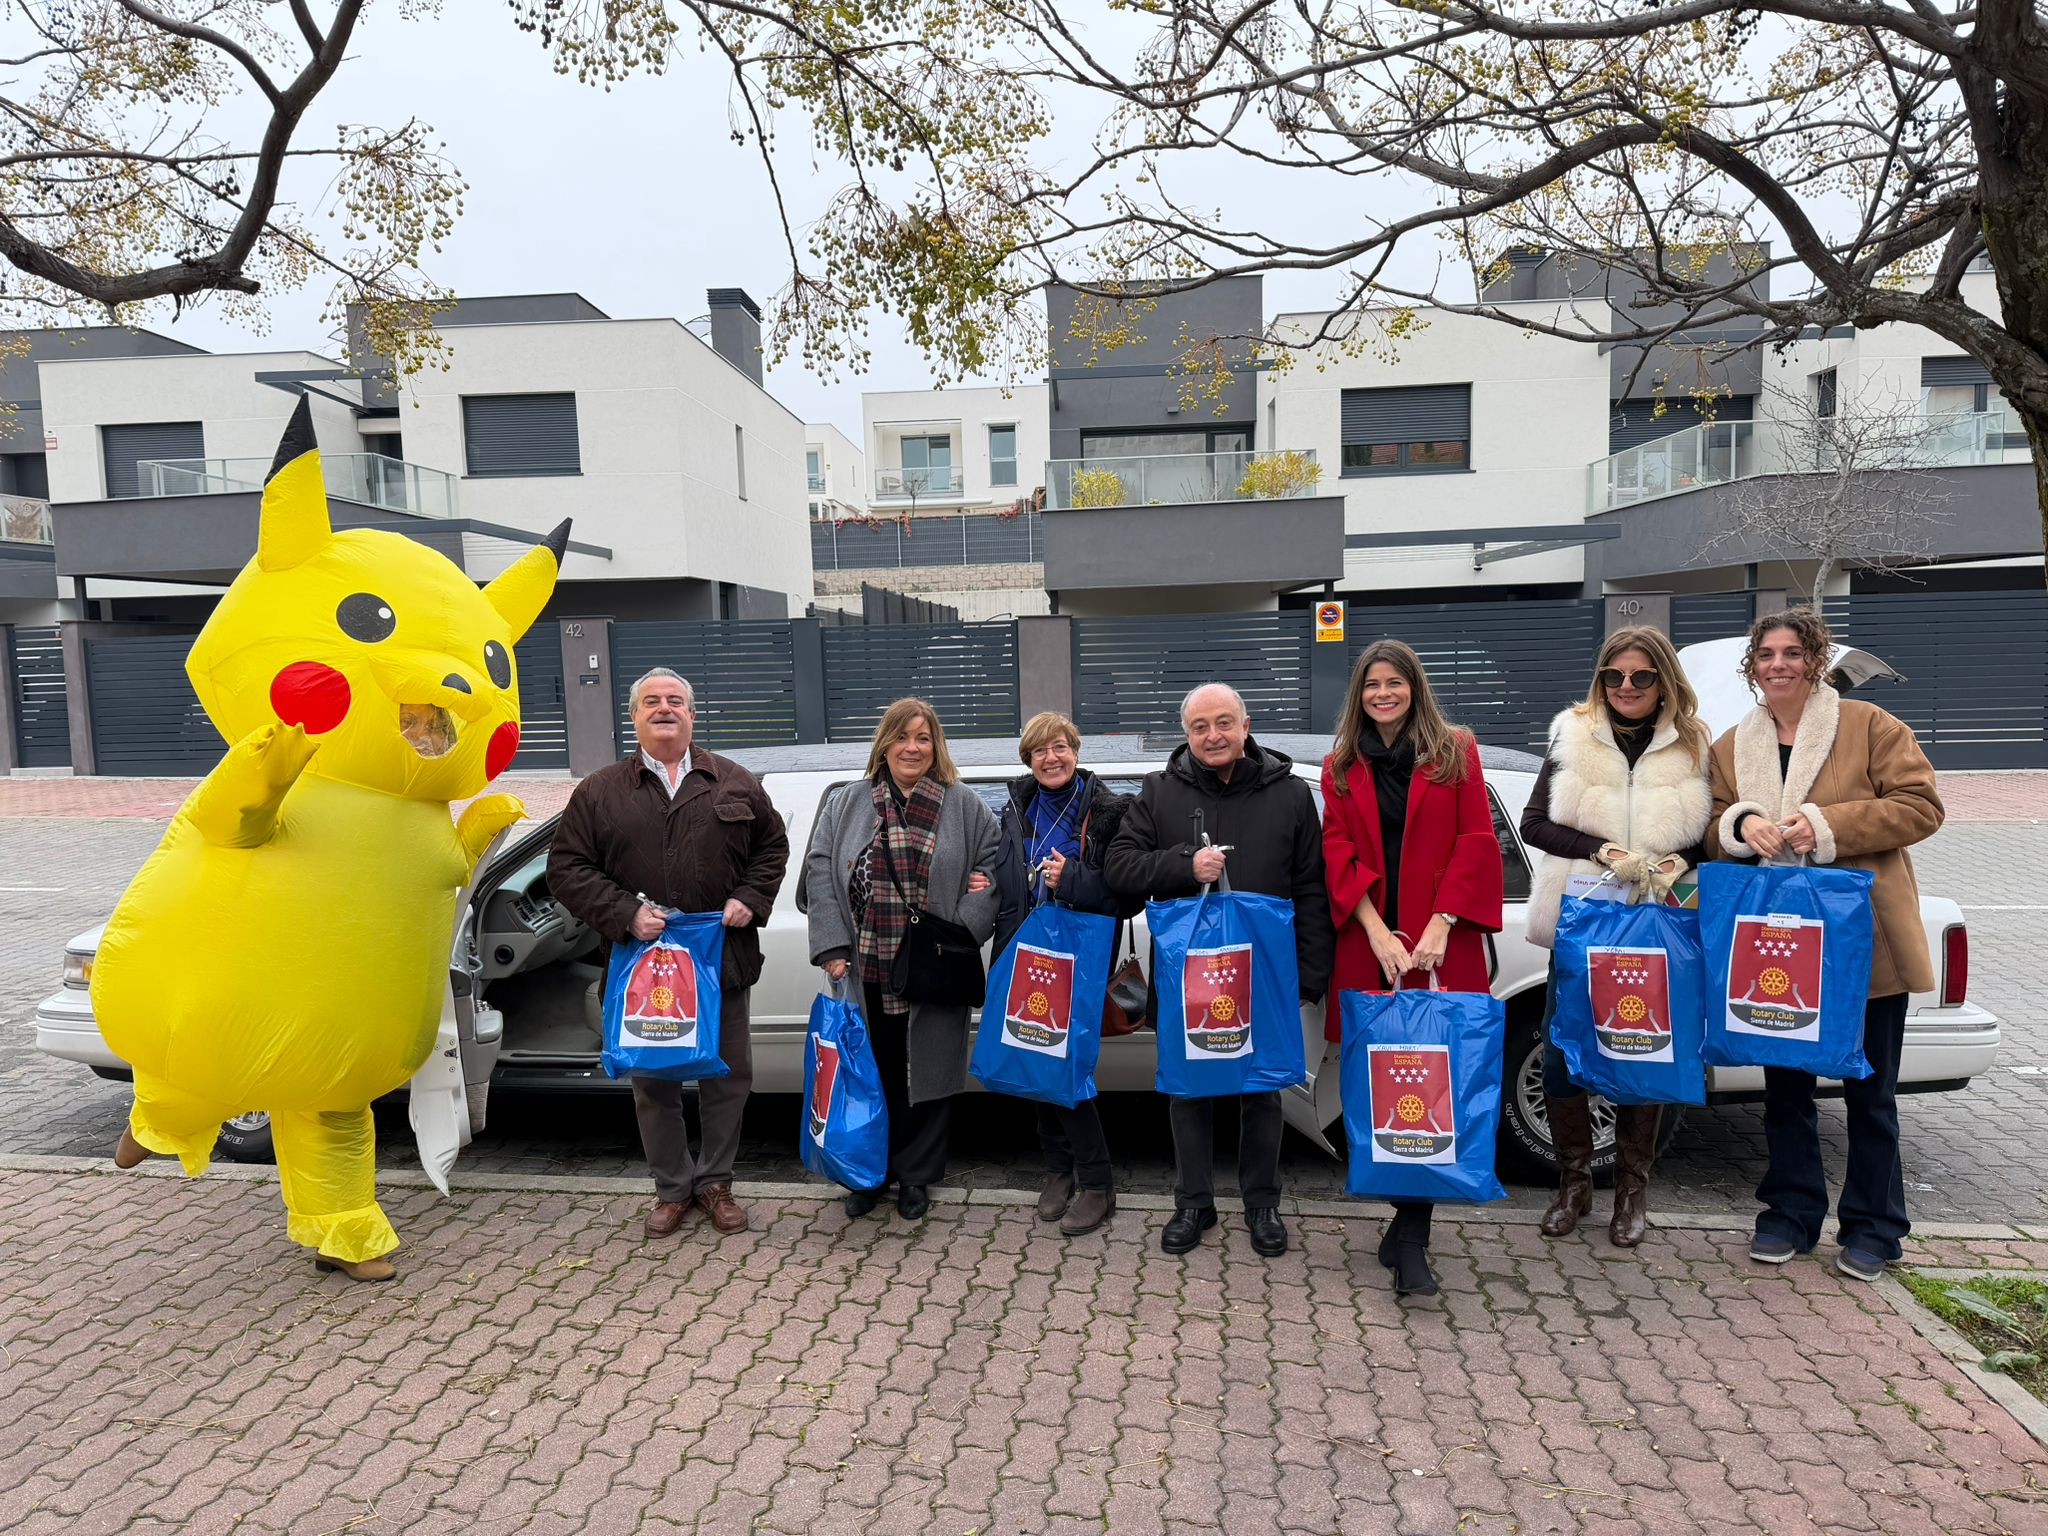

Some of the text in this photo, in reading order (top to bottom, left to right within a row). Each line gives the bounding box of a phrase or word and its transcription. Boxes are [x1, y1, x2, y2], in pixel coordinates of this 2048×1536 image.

[1617, 600, 1640, 615] 40
[566, 623, 583, 637] 42
[1751, 1009, 1795, 1020] Rotary Club
[642, 1022, 663, 1032] Rotary
[1750, 1017, 1766, 1025] Sierra
[1774, 1020, 1795, 1028] Madrid
[1019, 1025, 1037, 1036] Rotary
[1207, 1034, 1228, 1043] Rotary
[1611, 1035, 1652, 1044] Rotary Club
[1393, 1137, 1433, 1147] Rotary Club
